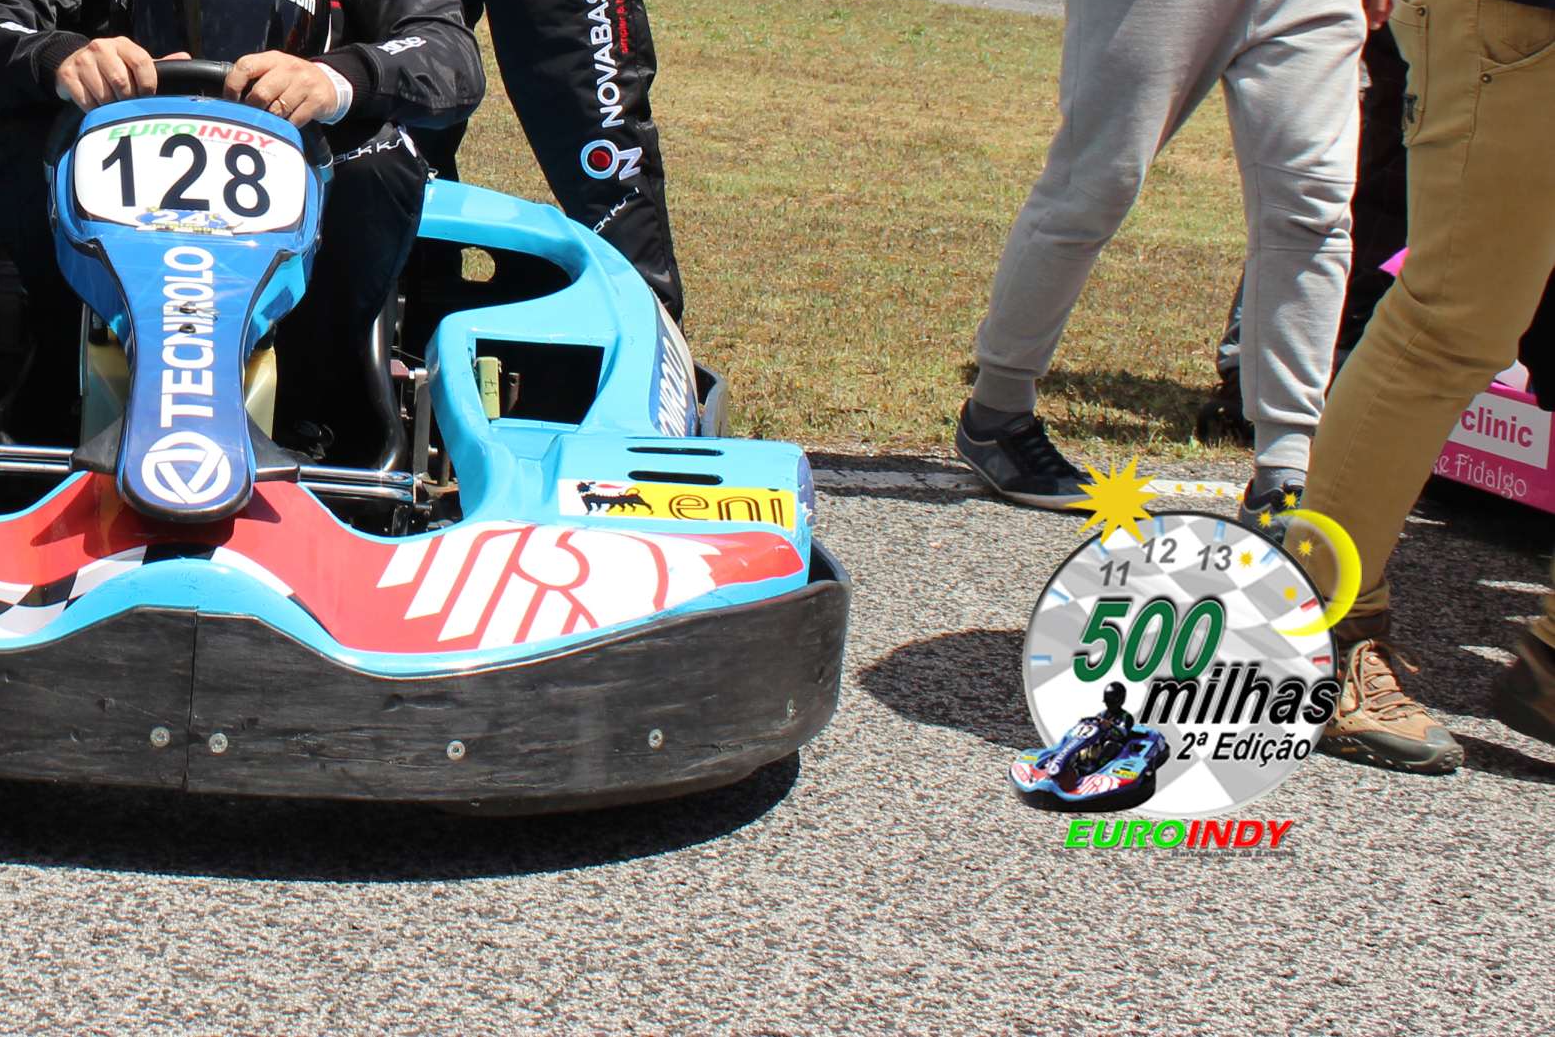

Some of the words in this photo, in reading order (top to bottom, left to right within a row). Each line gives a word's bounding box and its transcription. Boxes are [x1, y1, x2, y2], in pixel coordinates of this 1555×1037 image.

[101, 132, 271, 218] 128
[160, 245, 215, 429] TECNIROLO
[1460, 406, 1534, 448] clinic
[1455, 452, 1528, 500] Fidalgo
[668, 487, 786, 526] eni
